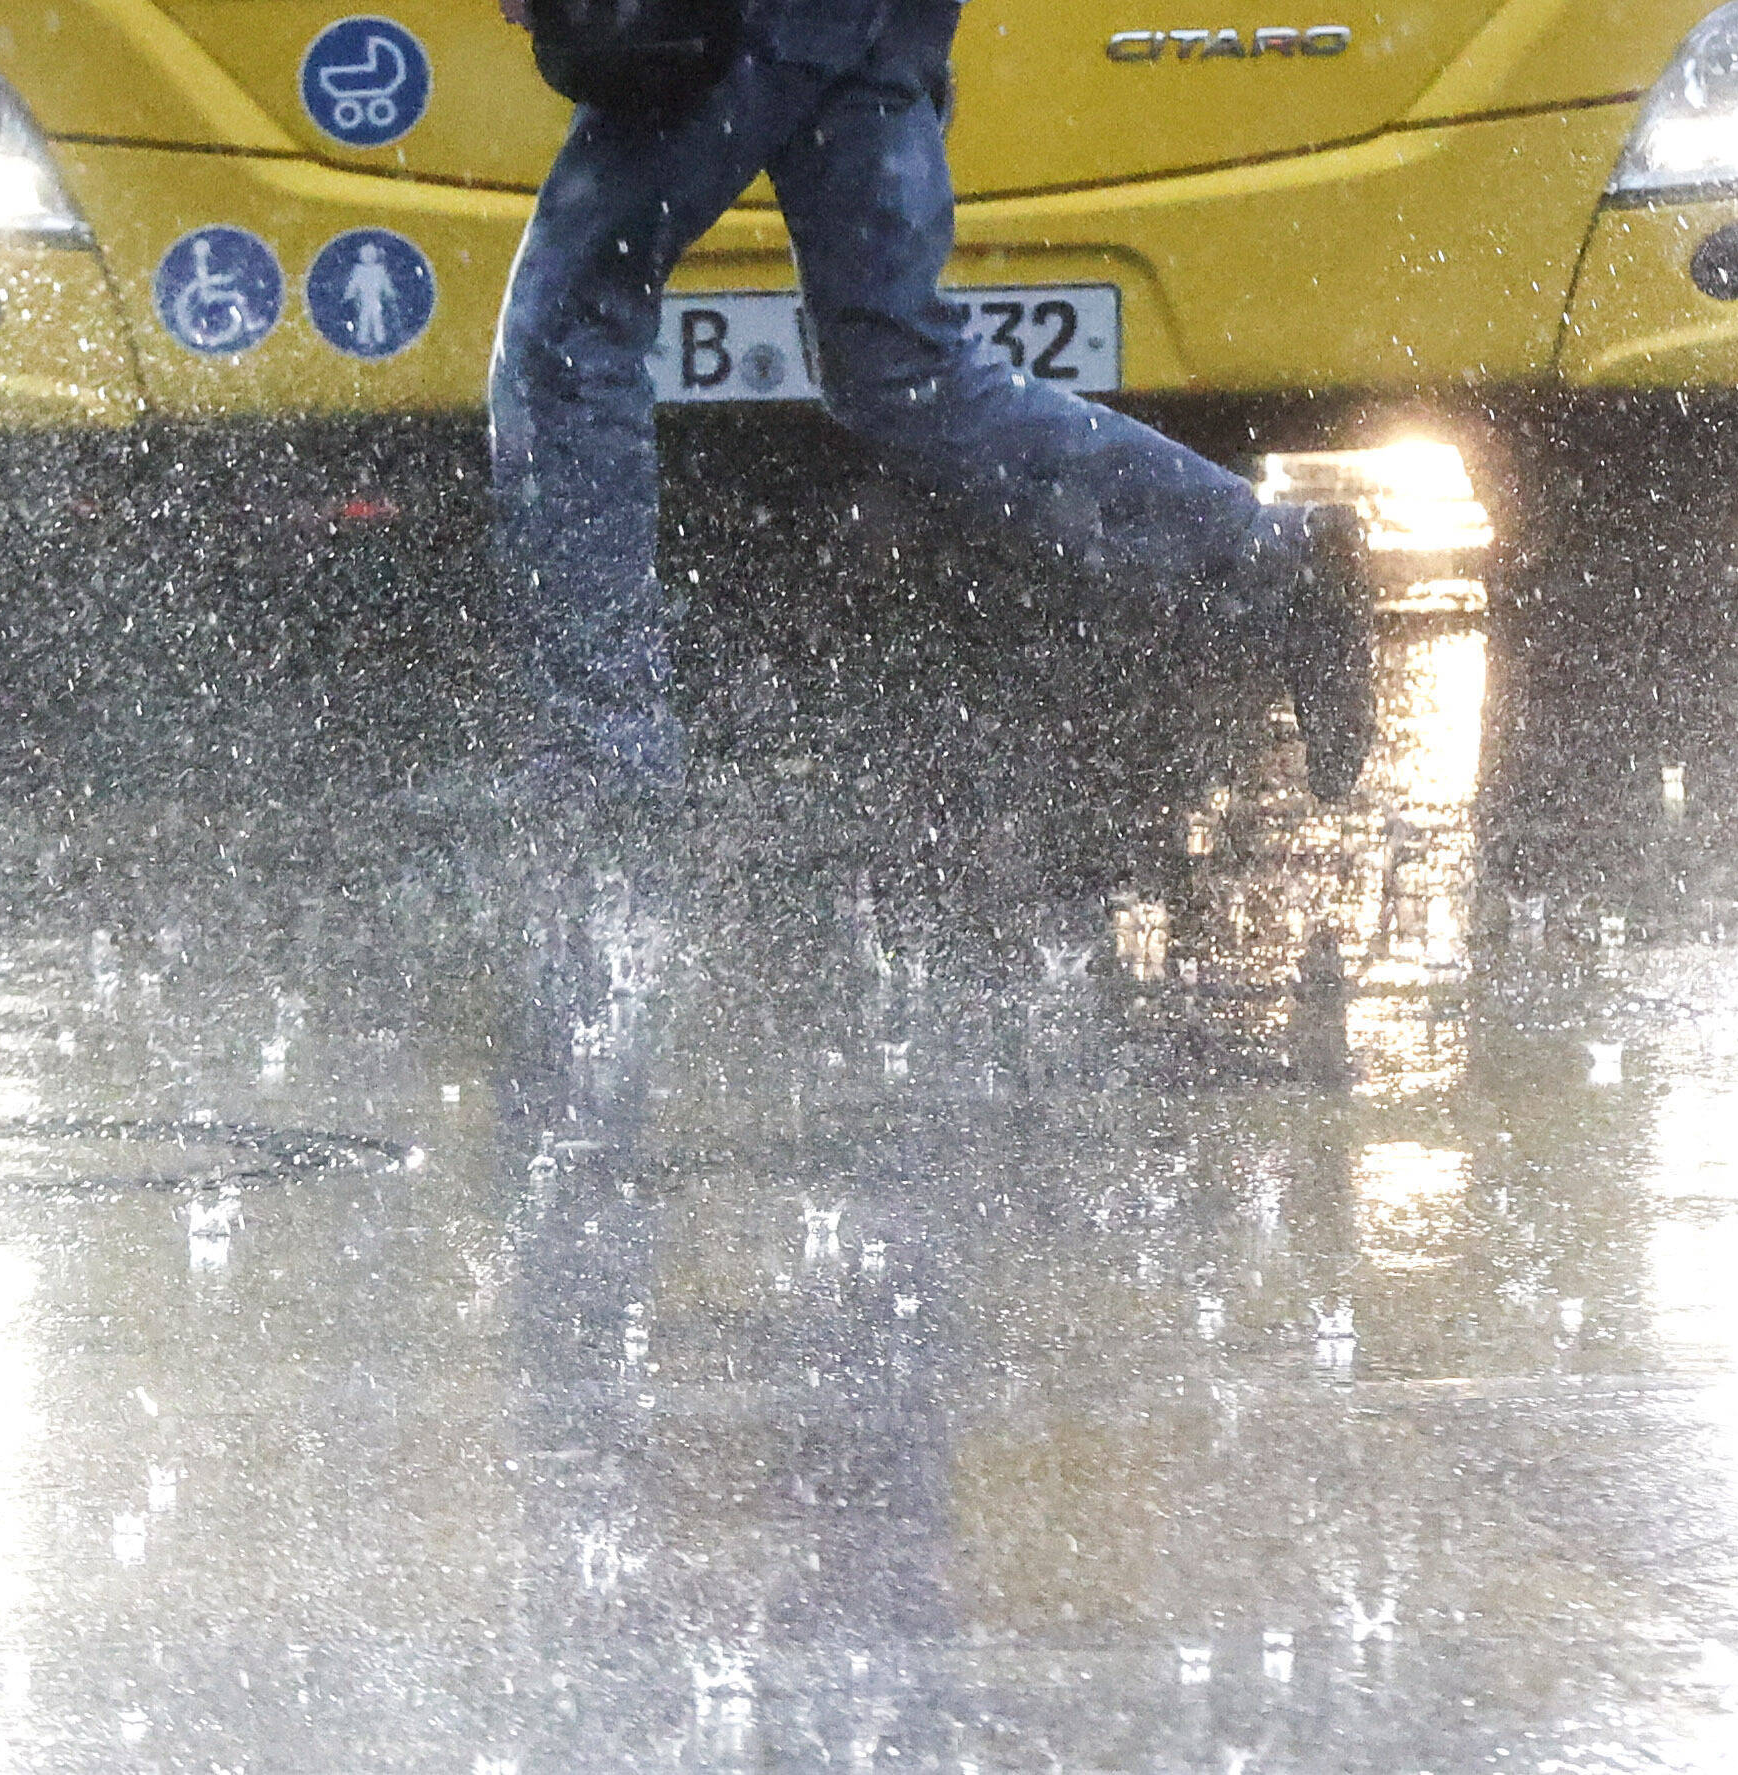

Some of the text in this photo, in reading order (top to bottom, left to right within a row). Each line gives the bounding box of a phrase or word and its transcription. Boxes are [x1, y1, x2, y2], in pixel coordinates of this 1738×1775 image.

[1106, 25, 1352, 62] CITARO
[680, 308, 732, 387] B
[962, 300, 1078, 379] 32
